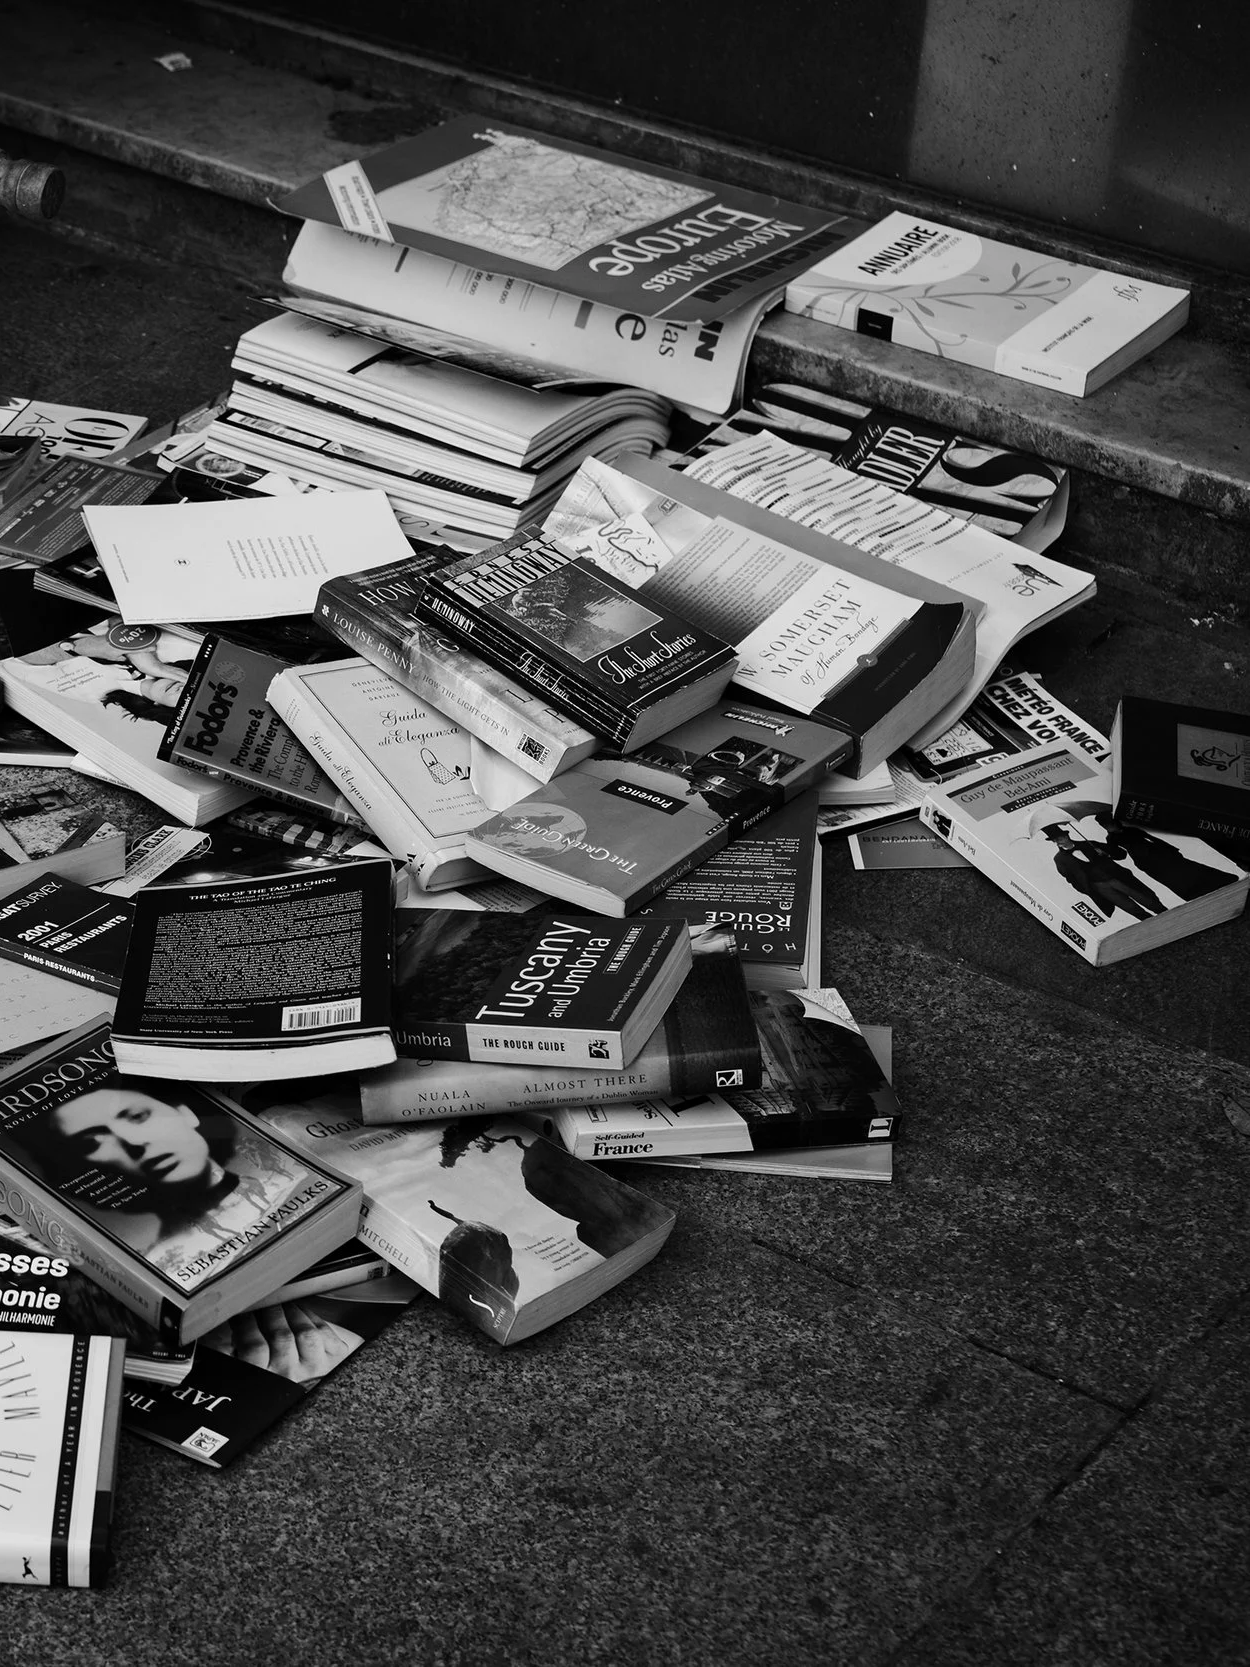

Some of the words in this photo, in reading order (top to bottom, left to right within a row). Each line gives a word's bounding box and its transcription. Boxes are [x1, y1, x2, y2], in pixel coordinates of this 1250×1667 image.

[588, 203, 776, 277] Europe
[696, 220, 806, 266] Motoring
[858, 224, 938, 277] ANNUAIRE
[641, 261, 709, 293] Atlas
[689, 230, 847, 303] MICHELIN
[451, 537, 548, 585] ERNEST
[461, 544, 573, 604] HEMINGWAY
[358, 580, 417, 607] HOW
[432, 597, 476, 634] HEMINGWAY
[738, 660, 764, 679] W.
[759, 578, 851, 662] SOMERSET
[333, 612, 374, 646] LOUISE
[376, 643, 417, 675] PENNY
[771, 598, 864, 678] MAUGHAM
[813, 646, 846, 682] Human
[837, 614, 879, 648] Bondage
[598, 654, 631, 685] The
[624, 645, 660, 674] Short
[649, 630, 697, 660] Stories
[422, 674, 439, 690] HOW
[439, 684, 455, 701] THE
[456, 696, 481, 717] LIGHT
[480, 711, 499, 731] GETS
[499, 725, 510, 737] IN
[986, 685, 1033, 720] CHEZ
[1004, 677, 1054, 716] MÉTÉO
[1047, 714, 1105, 755] FRANCE
[183, 680, 238, 757] Fodor's
[380, 707, 427, 728] Guida
[723, 712, 777, 731] MICHELIN
[230, 720, 262, 768] Provence
[248, 708, 265, 722] &
[254, 717, 282, 763] Riviera
[308, 732, 333, 765] Guida
[248, 756, 266, 775] the
[267, 764, 284, 781] The
[292, 760, 305, 777] the
[223, 773, 273, 797] Provence
[289, 774, 299, 789] to
[960, 786, 987, 804] Guy
[988, 778, 1004, 792] de
[1004, 757, 1074, 788] Maupassant
[1003, 777, 1052, 800] Bel-Ami
[617, 784, 674, 810] Provence
[742, 804, 772, 830] Provence
[210, 891, 230, 899] TAO
[231, 889, 245, 897] OF
[248, 886, 267, 895] THE
[267, 884, 288, 893] TAO
[290, 881, 302, 890] TE
[303, 876, 337, 886] CHING
[705, 911, 792, 927] ROUGE
[1074, 900, 1104, 927] POCKET
[17, 920, 59, 942] 2001
[39, 931, 73, 949] PARIS
[53, 914, 128, 953] RESTAURANTS
[1061, 922, 1087, 950] POCKET
[606, 962, 620, 972] THE
[614, 943, 630, 963] ROUGH
[626, 926, 643, 945] GUIDE
[23, 952, 45, 966] PARIS
[45, 960, 96, 982] RESTAURANTS
[475, 921, 591, 1019] Tuscany
[547, 938, 611, 995] Umbria
[548, 999, 572, 1018] and
[395, 1030, 451, 1050] Umbria
[483, 1038, 499, 1048] THE
[504, 1040, 534, 1050] ROUGH
[538, 1041, 565, 1051] GUIDE
[418, 1090, 470, 1102] NUALA
[507, 1100, 522, 1108] The
[523, 1098, 553, 1107] Onward
[555, 1095, 584, 1106] Journey
[601, 1091, 626, 1100] Dublin
[629, 1089, 659, 1098] Woman
[523, 1080, 586, 1094] ALMOST
[594, 1074, 647, 1087] THERE
[4, 1111, 39, 1130] NOVEL
[41, 1103, 54, 1112] OF
[58, 1085, 84, 1103] LOVE
[88, 1071, 110, 1087] AND
[402, 1102, 486, 1117] O'FAOLAIN
[349, 1133, 384, 1151] DAVID
[592, 1141, 653, 1157] France
[595, 1132, 645, 1142] Self-Guided
[176, 1219, 272, 1283] SEBASTIAN
[267, 1180, 329, 1228] FAULKS
[358, 1223, 411, 1267] MITCHELL
[116, 1281, 150, 1309] FAULKS
[71, 1341, 86, 1398] PROVENCE
[70, 1406, 78, 1418] IN
[66, 1426, 76, 1453] YEAR
